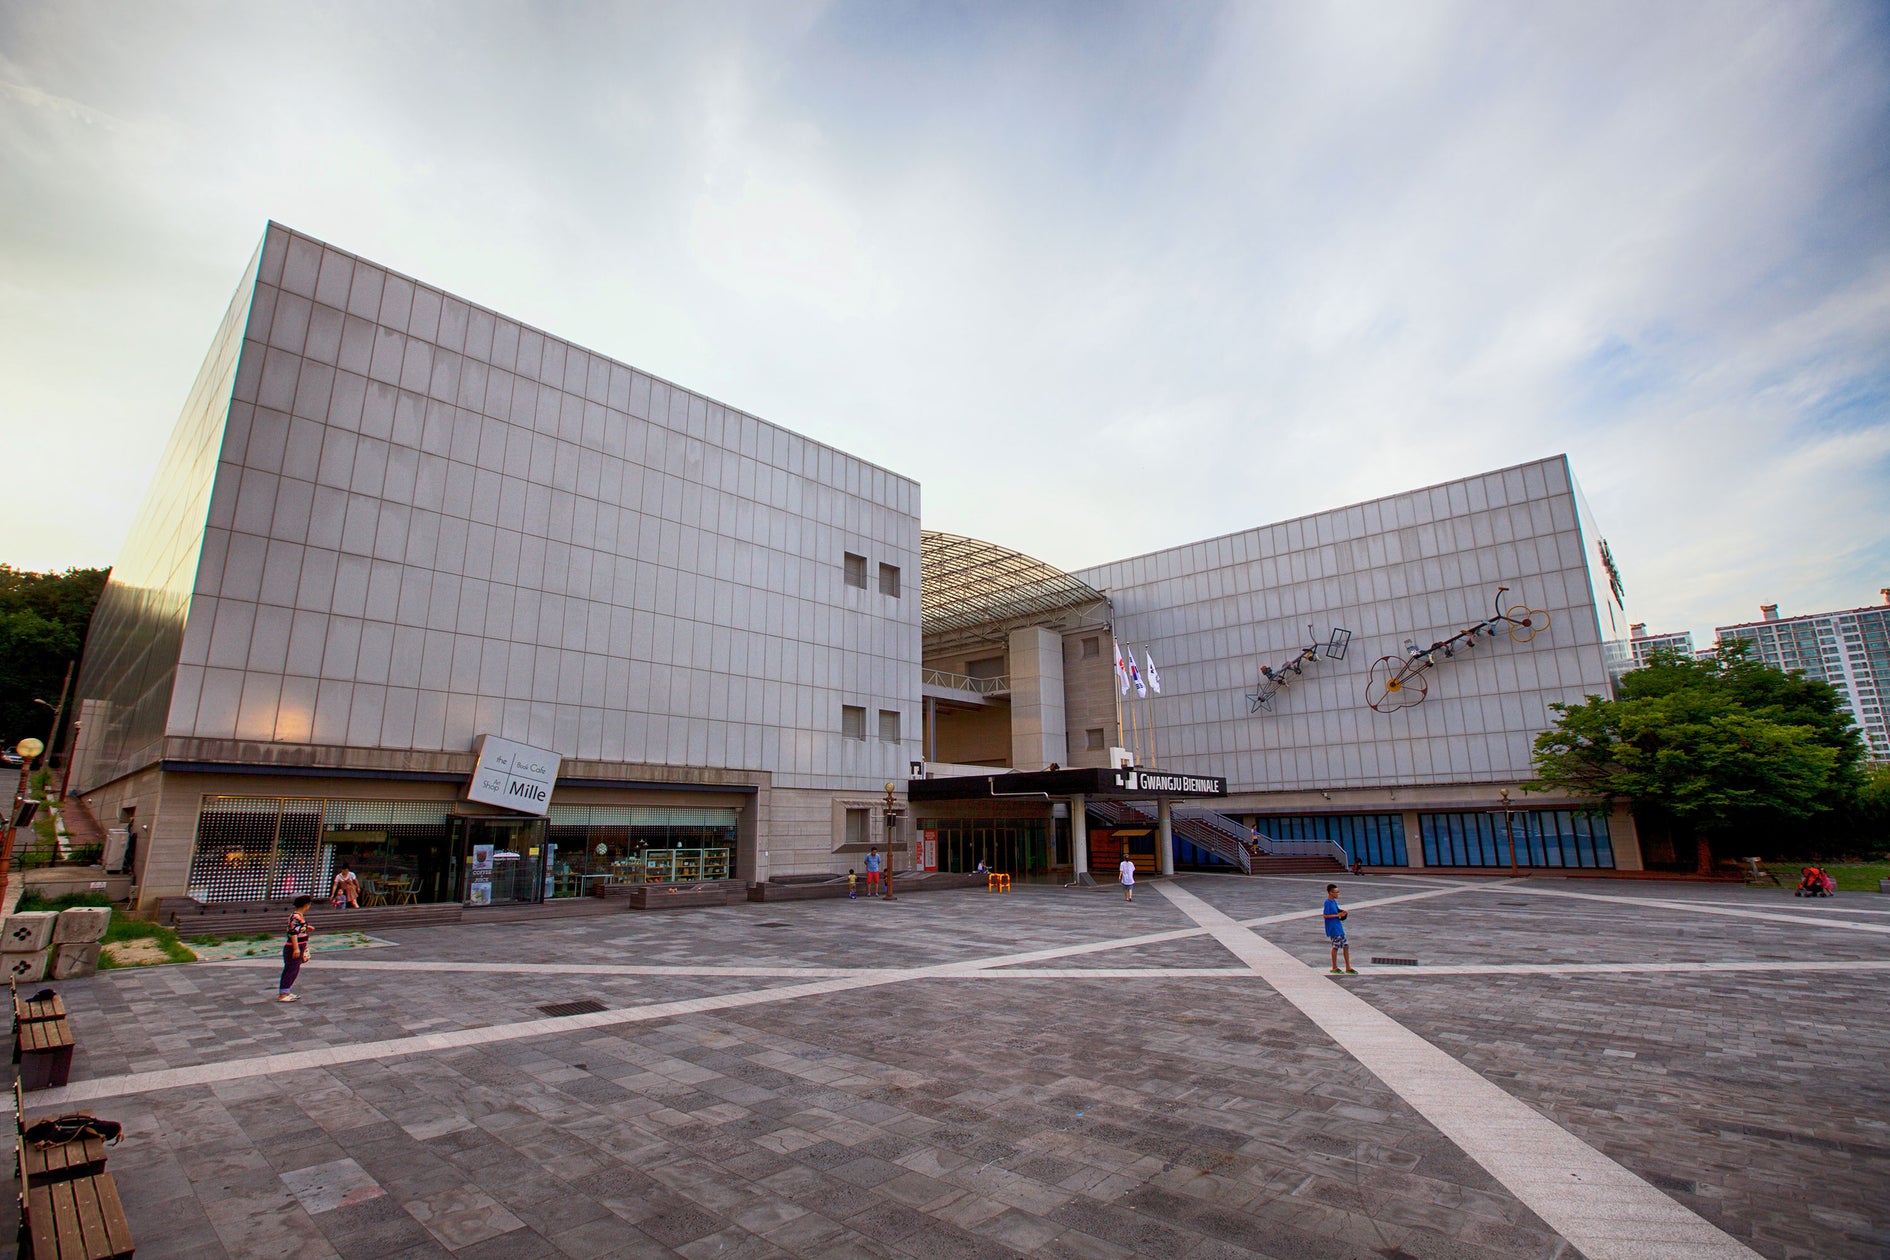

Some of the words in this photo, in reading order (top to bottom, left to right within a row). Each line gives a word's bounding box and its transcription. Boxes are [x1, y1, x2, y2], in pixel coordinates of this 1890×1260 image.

[496, 755, 508, 765] the
[482, 780, 500, 793] Shop
[509, 781, 546, 802] Mille
[1140, 774, 1182, 791] GWANGJU
[1182, 776, 1220, 793] BIENNALE
